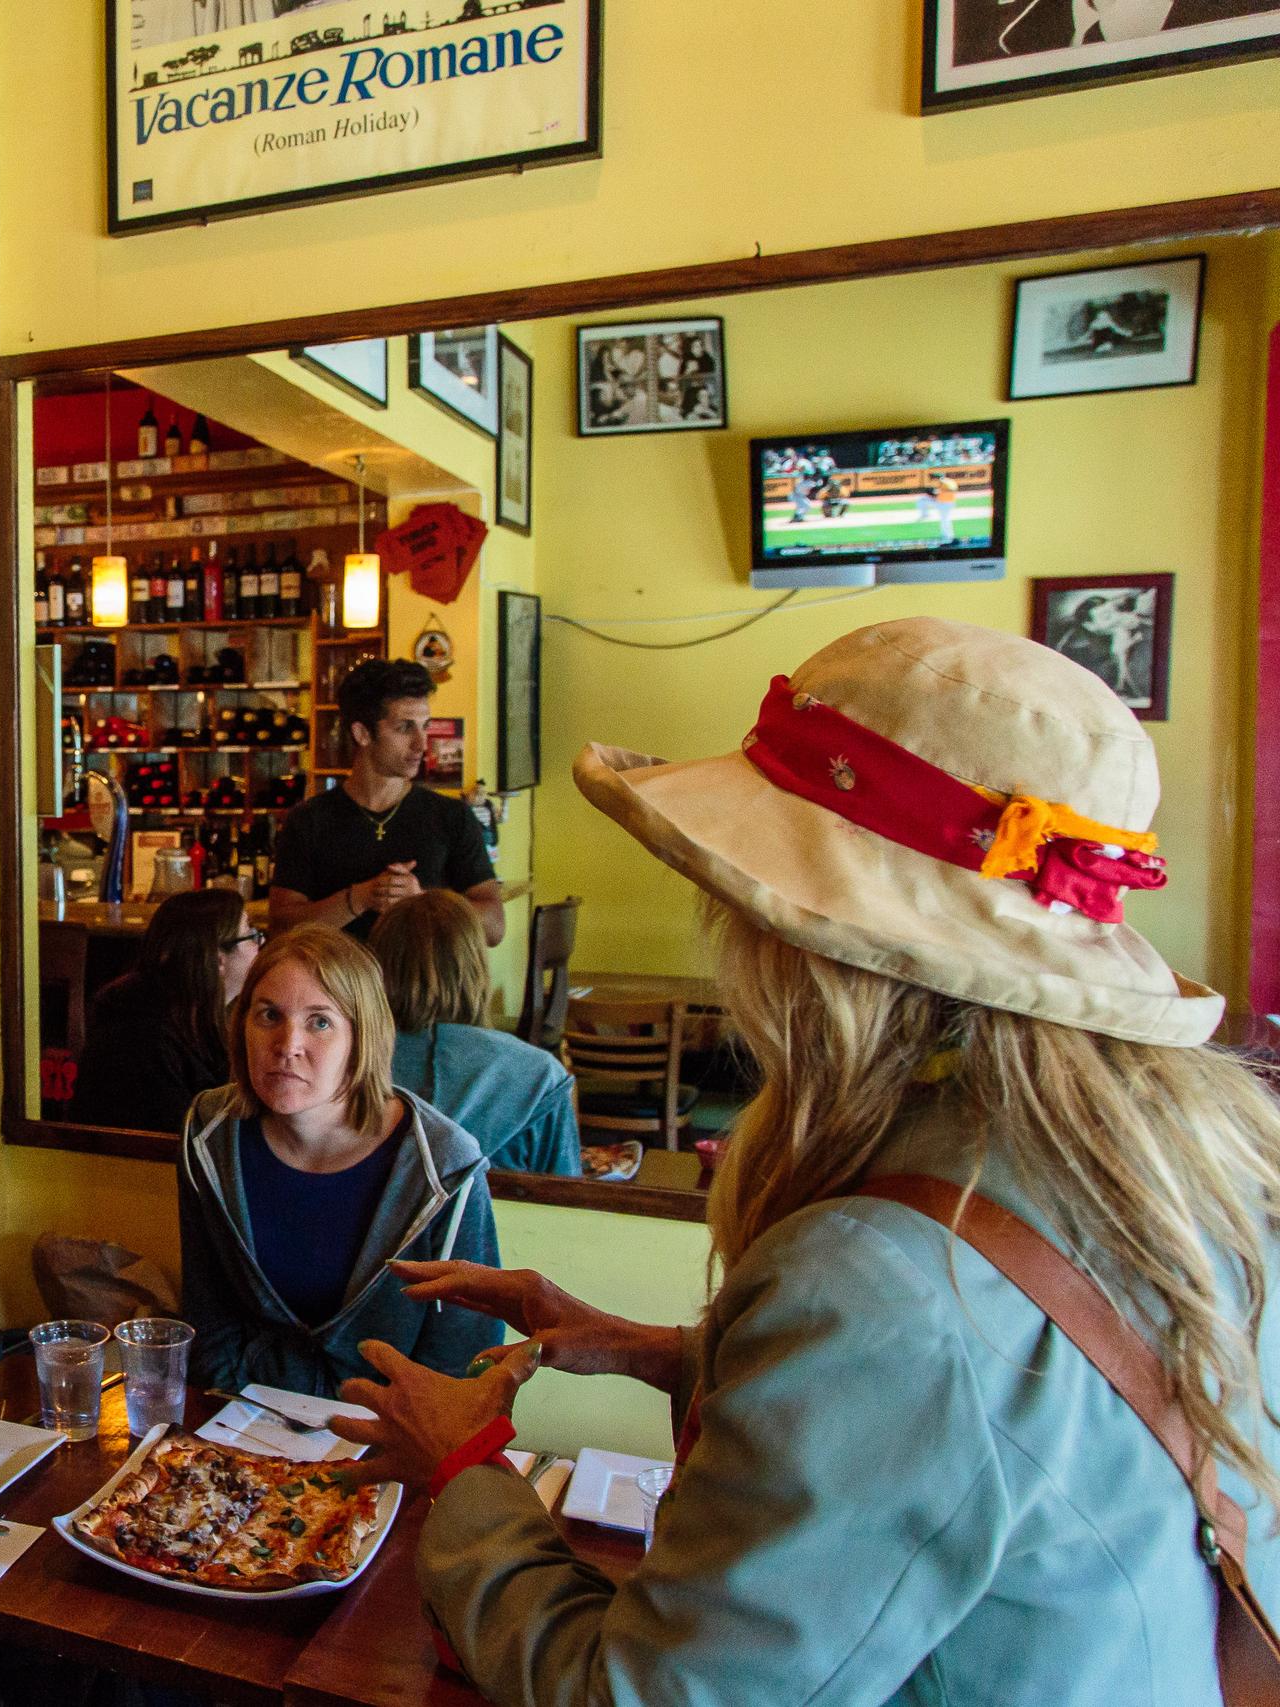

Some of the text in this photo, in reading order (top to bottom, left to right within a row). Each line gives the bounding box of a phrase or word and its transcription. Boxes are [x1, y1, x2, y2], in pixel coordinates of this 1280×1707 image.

[129, 23, 564, 145] Vacanze Romane
[253, 106, 420, 158] (Roman Holiday)
